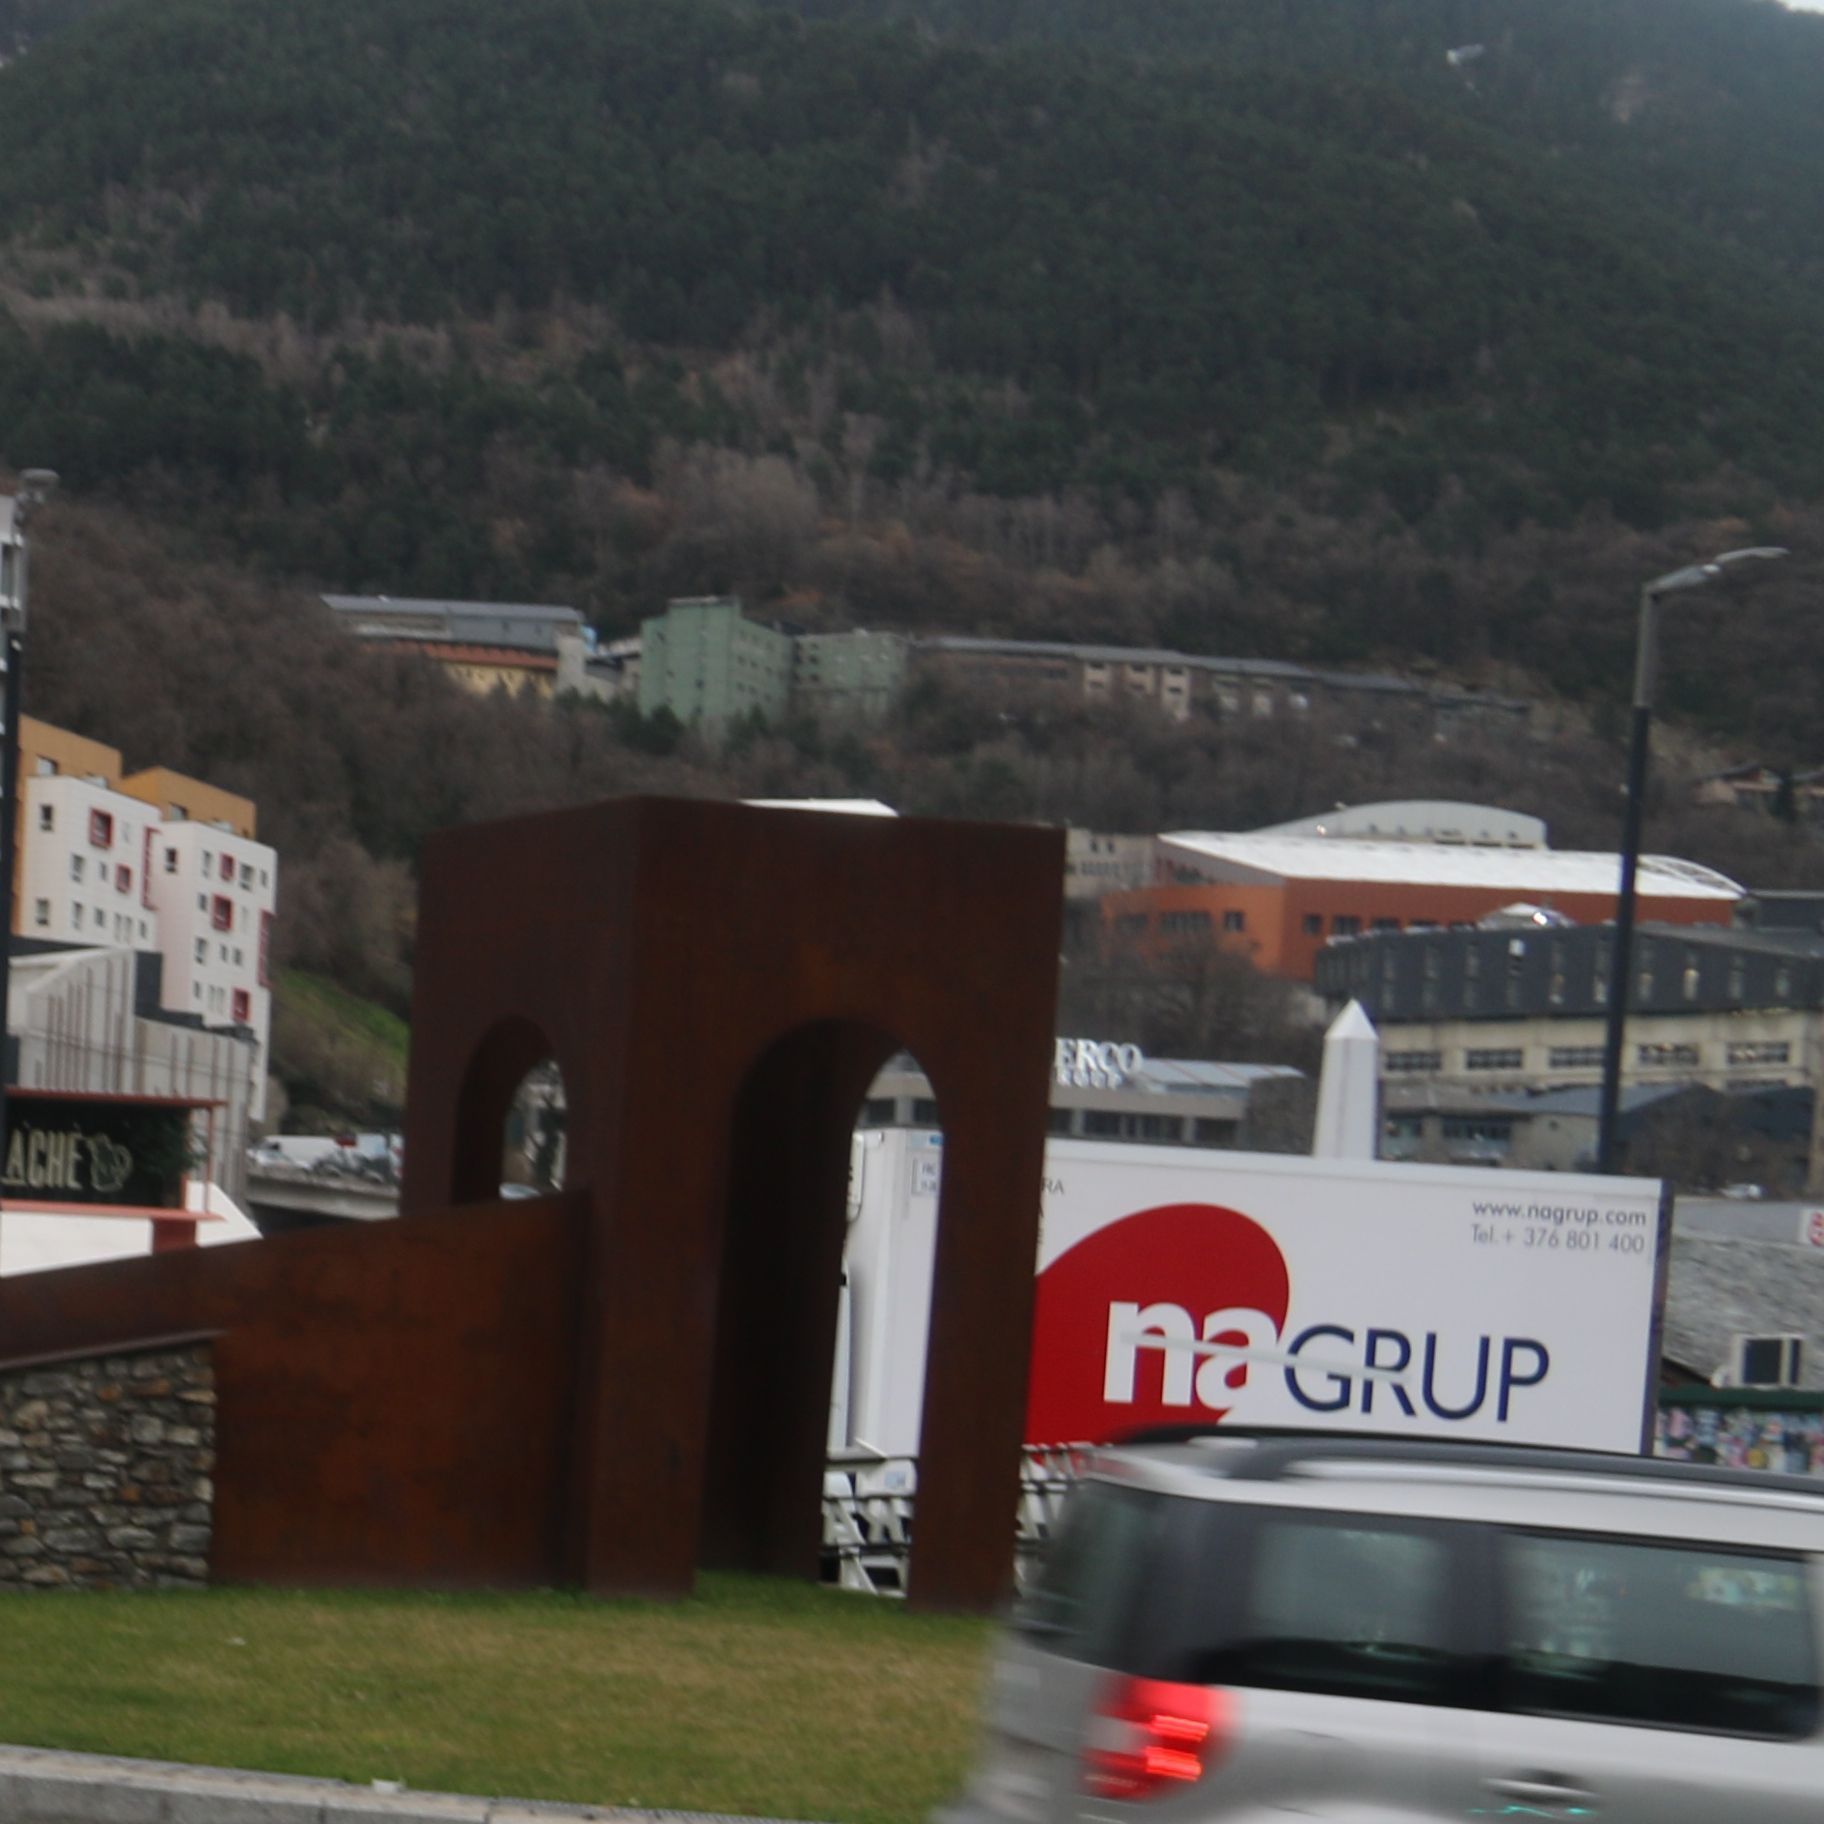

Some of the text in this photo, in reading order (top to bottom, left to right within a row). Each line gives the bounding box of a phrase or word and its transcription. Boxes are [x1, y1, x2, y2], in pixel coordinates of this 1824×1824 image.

[1055, 1037, 1144, 1076] ERCO
[1471, 1201, 1648, 1226] www.nagrup.com
[1523, 1226, 1560, 1249] 376
[1565, 1230, 1600, 1251] 801
[1608, 1234, 1646, 1255] 400
